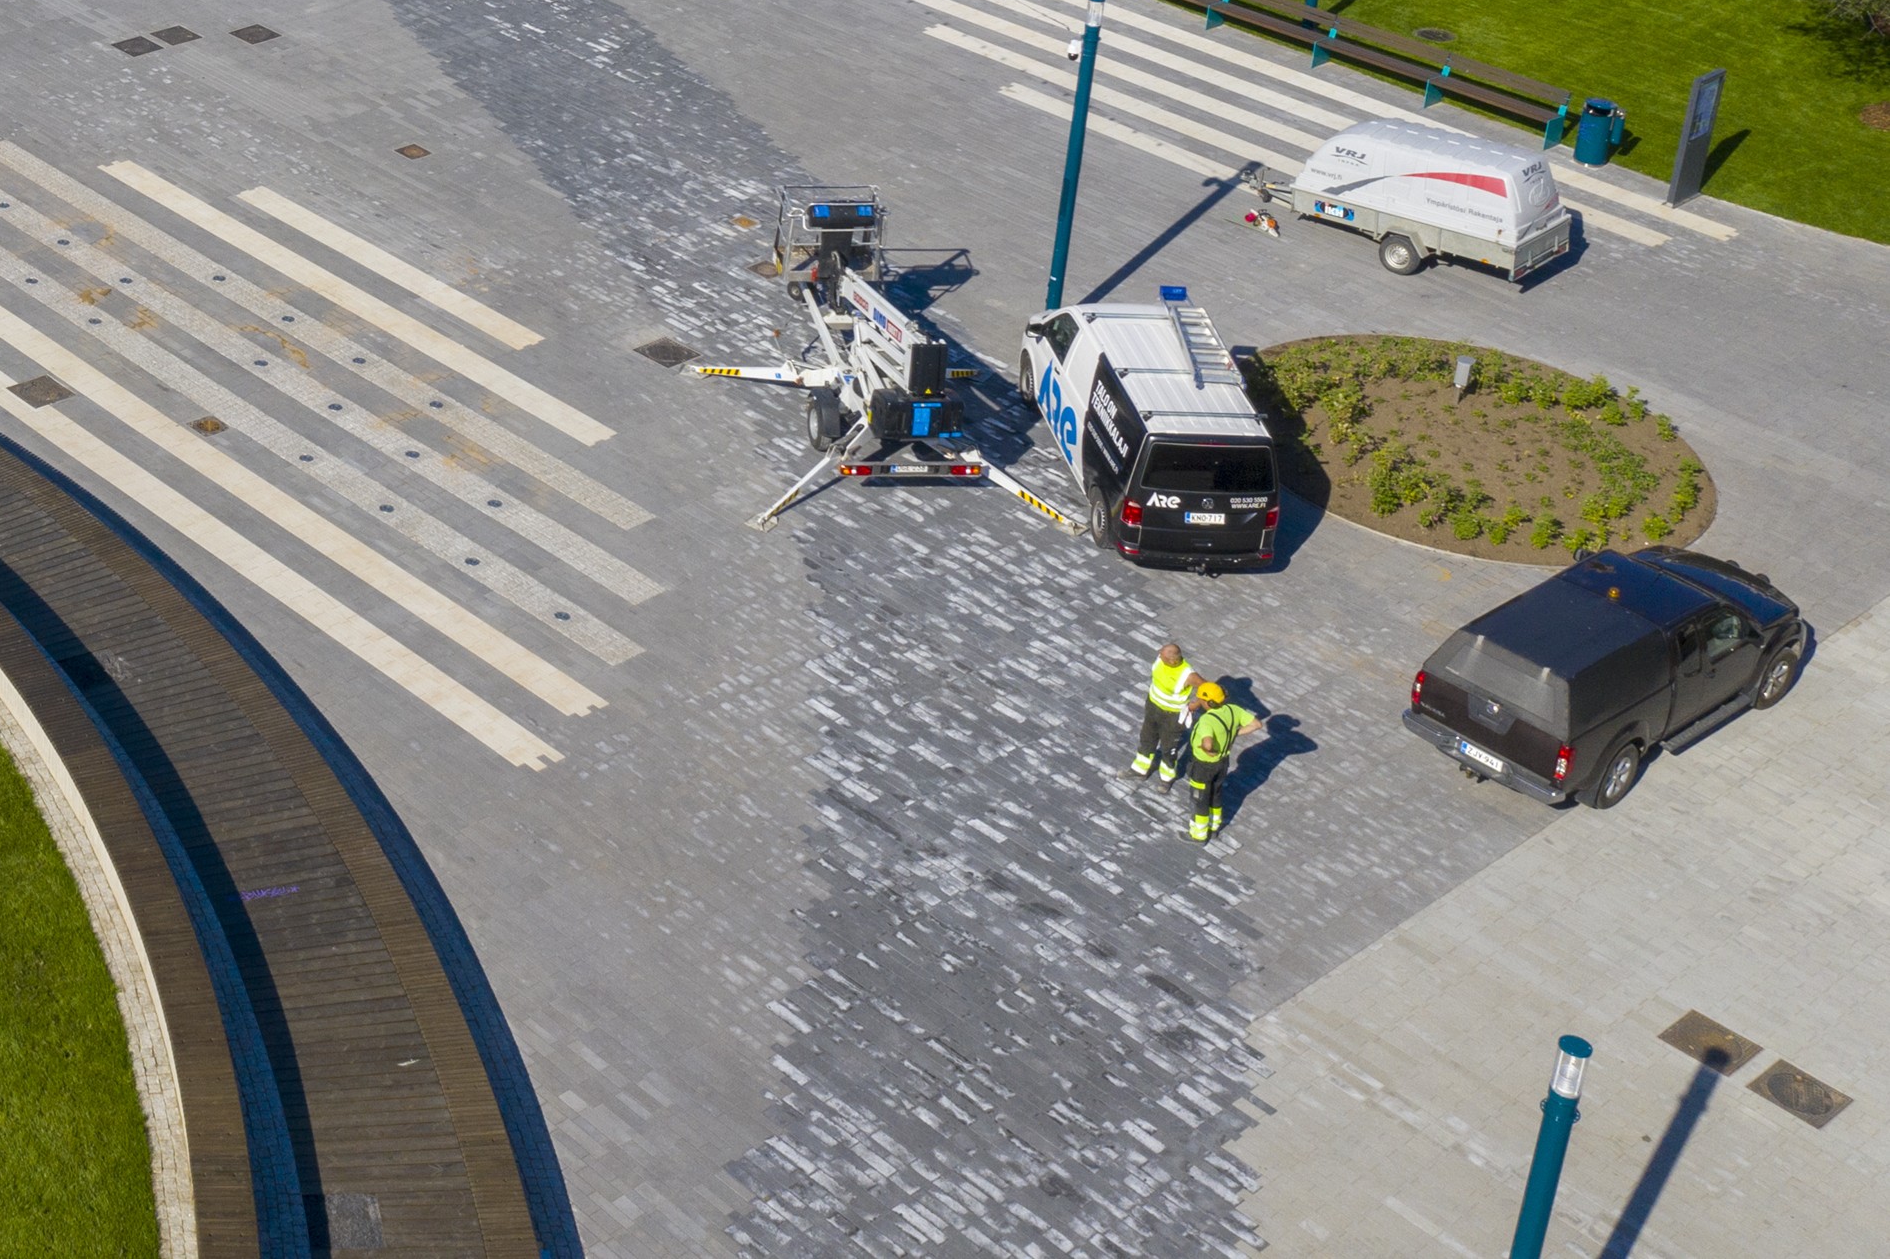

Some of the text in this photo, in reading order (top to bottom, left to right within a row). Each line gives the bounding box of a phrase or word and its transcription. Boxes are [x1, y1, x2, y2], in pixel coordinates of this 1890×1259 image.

[1335, 146, 1366, 160] VRJ
[1522, 161, 1542, 177] VRJ
[1468, 208, 1503, 223] Rakentaja
[1095, 379, 1110, 407] TALO
[1106, 400, 1118, 419] ON
